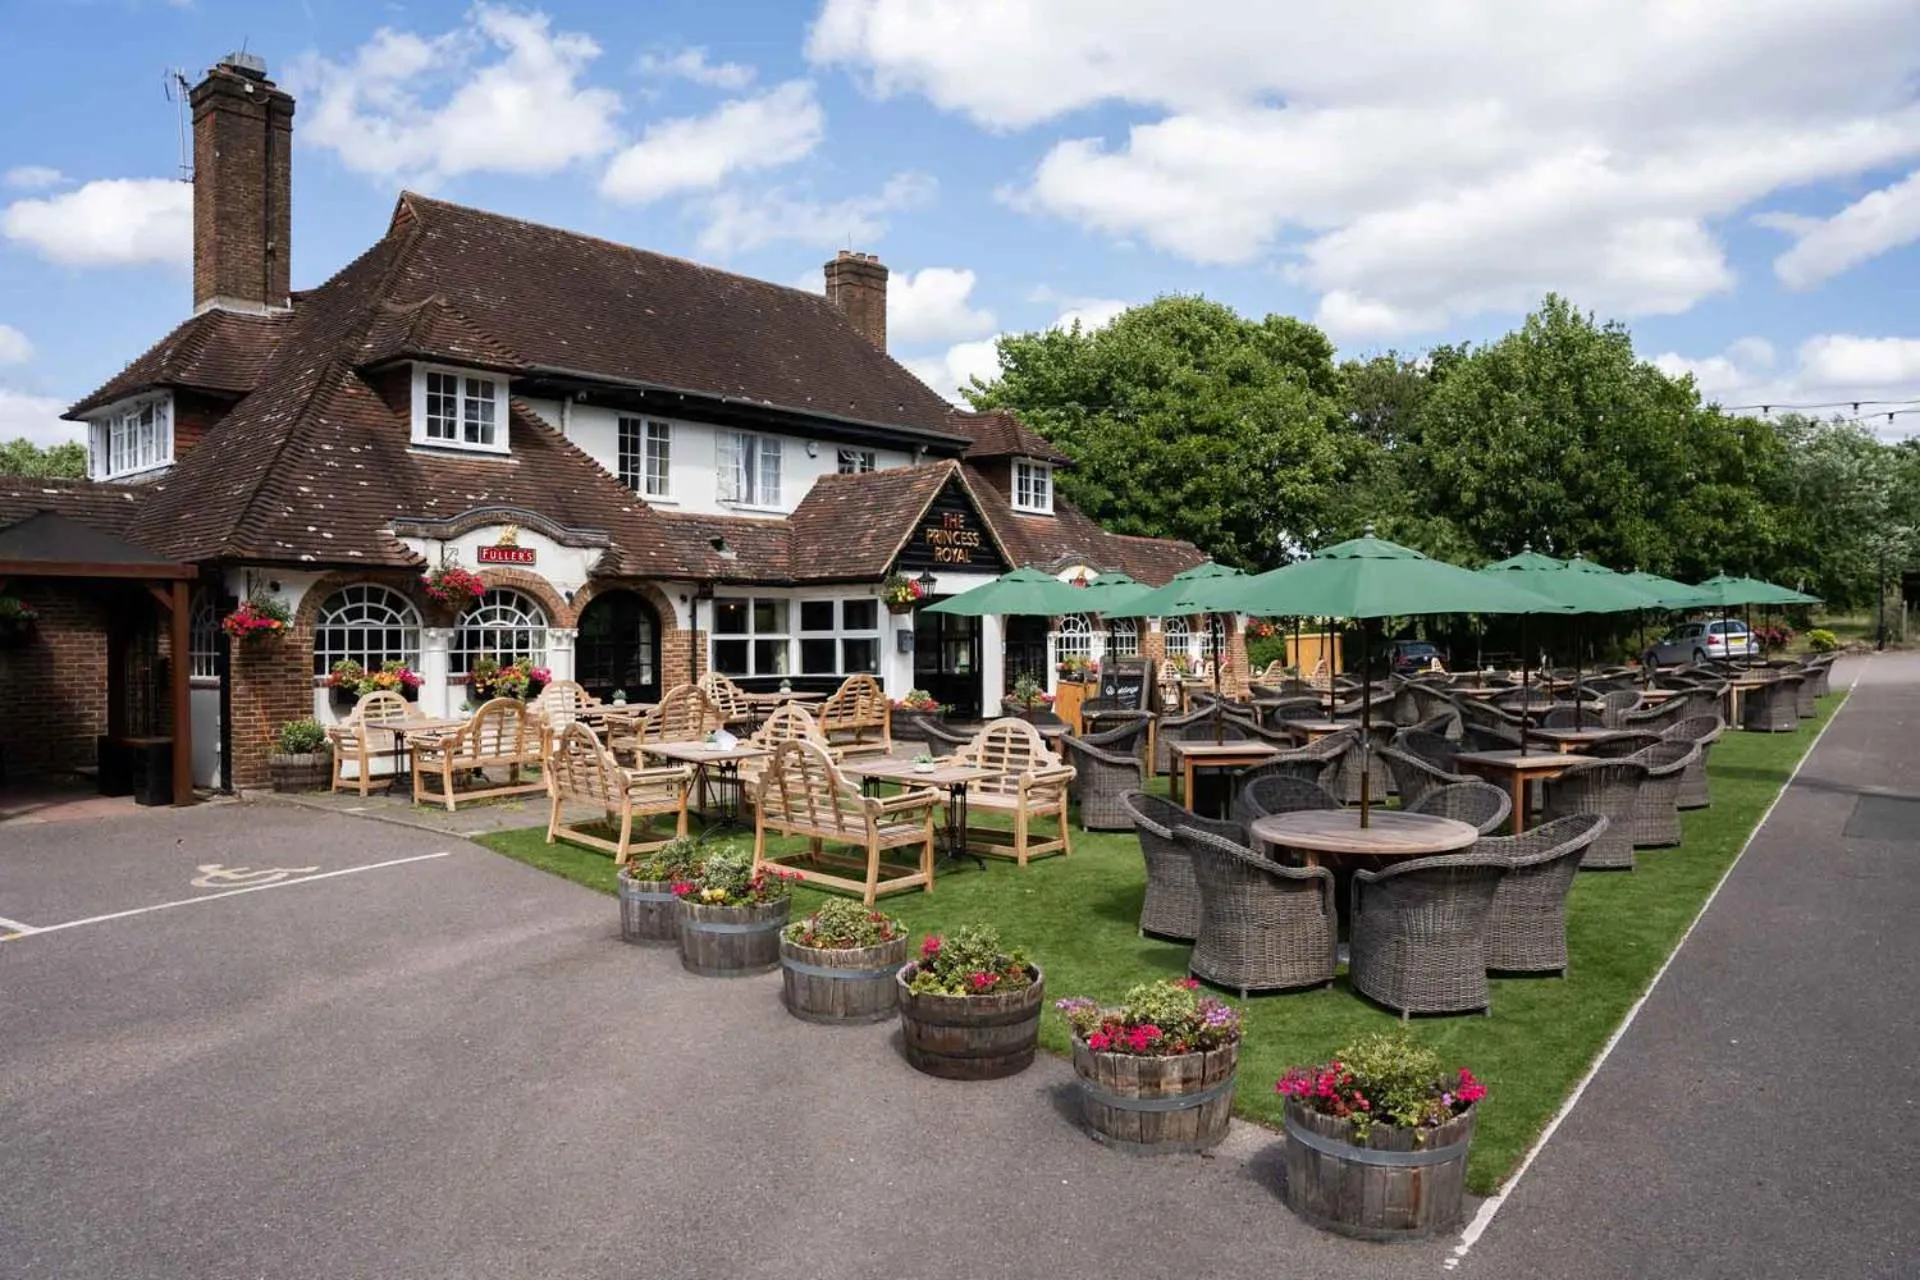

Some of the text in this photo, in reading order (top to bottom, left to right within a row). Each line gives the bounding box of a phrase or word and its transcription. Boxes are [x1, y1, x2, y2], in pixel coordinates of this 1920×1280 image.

[943, 512, 964, 528] THE
[927, 528, 979, 547] PRINCESS
[935, 546, 972, 563] ROYAL
